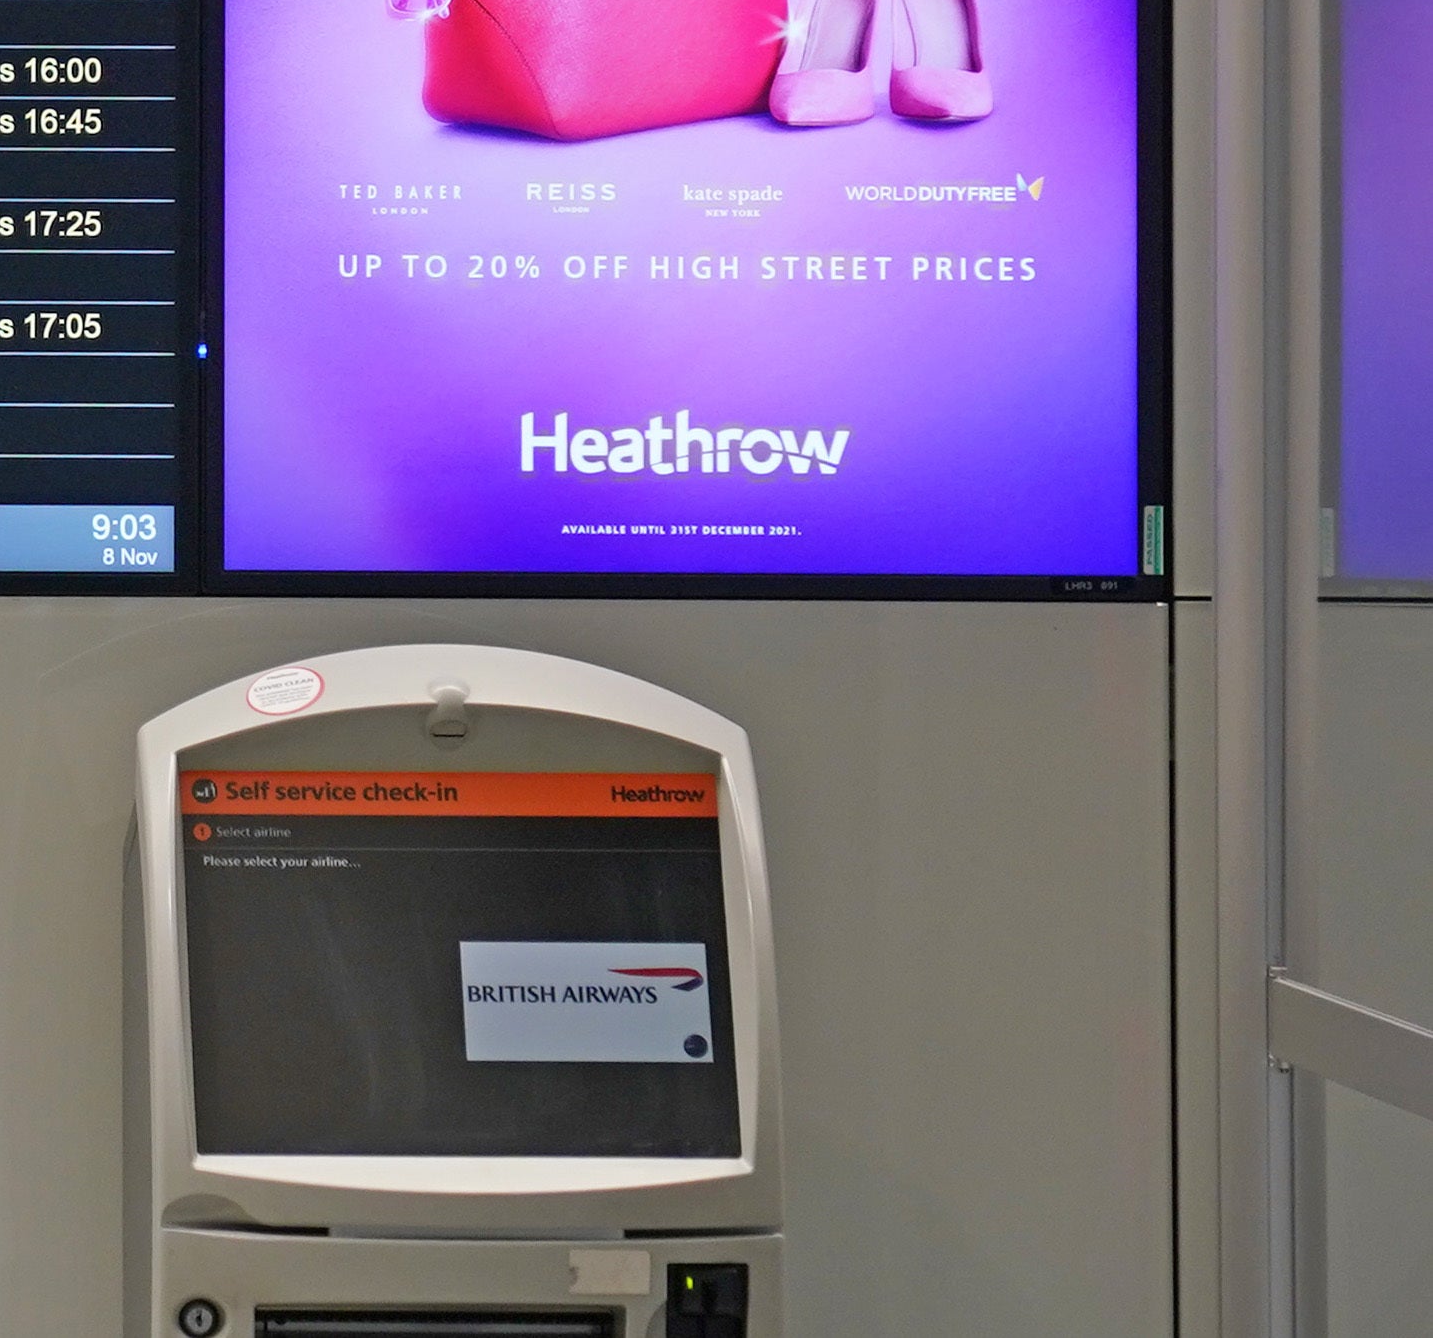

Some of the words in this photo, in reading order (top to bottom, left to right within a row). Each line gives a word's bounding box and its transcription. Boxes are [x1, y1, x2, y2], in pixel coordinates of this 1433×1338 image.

[340, 185, 377, 199] TED
[395, 185, 461, 199] BAKER
[527, 184, 615, 200] REISS
[684, 185, 722, 200] kate
[729, 186, 782, 205] spade
[339, 255, 381, 277] UP
[402, 254, 447, 277] TO
[469, 255, 539, 278] 20%
[564, 256, 627, 278] OFF
[651, 255, 738, 279] HIGH
[761, 256, 891, 280] STREET
[912, 256, 1038, 282] PRICES
[25, 313, 101, 338] 17:05
[521, 409, 850, 474] Heathrow
[93, 514, 156, 540] 9:03
[562, 525, 626, 534] AVAILABLE
[631, 526, 665, 534] UNTIL
[671, 526, 697, 534] 31ST
[702, 526, 764, 535] DECEMBER
[769, 526, 801, 535] 2021.
[103, 548, 114, 565] 8
[121, 548, 157, 565] Nov
[225, 781, 269, 800] Self
[275, 782, 356, 801] service
[363, 782, 457, 801] check-in
[611, 785, 705, 802] Heathrow
[217, 827, 250, 837] Select
[254, 827, 291, 837] airline
[204, 856, 240, 866] Please
[244, 856, 277, 866] select
[280, 859, 307, 869] your
[468, 986, 555, 1003] BRITISH
[563, 986, 657, 1003] AIRWAYS
